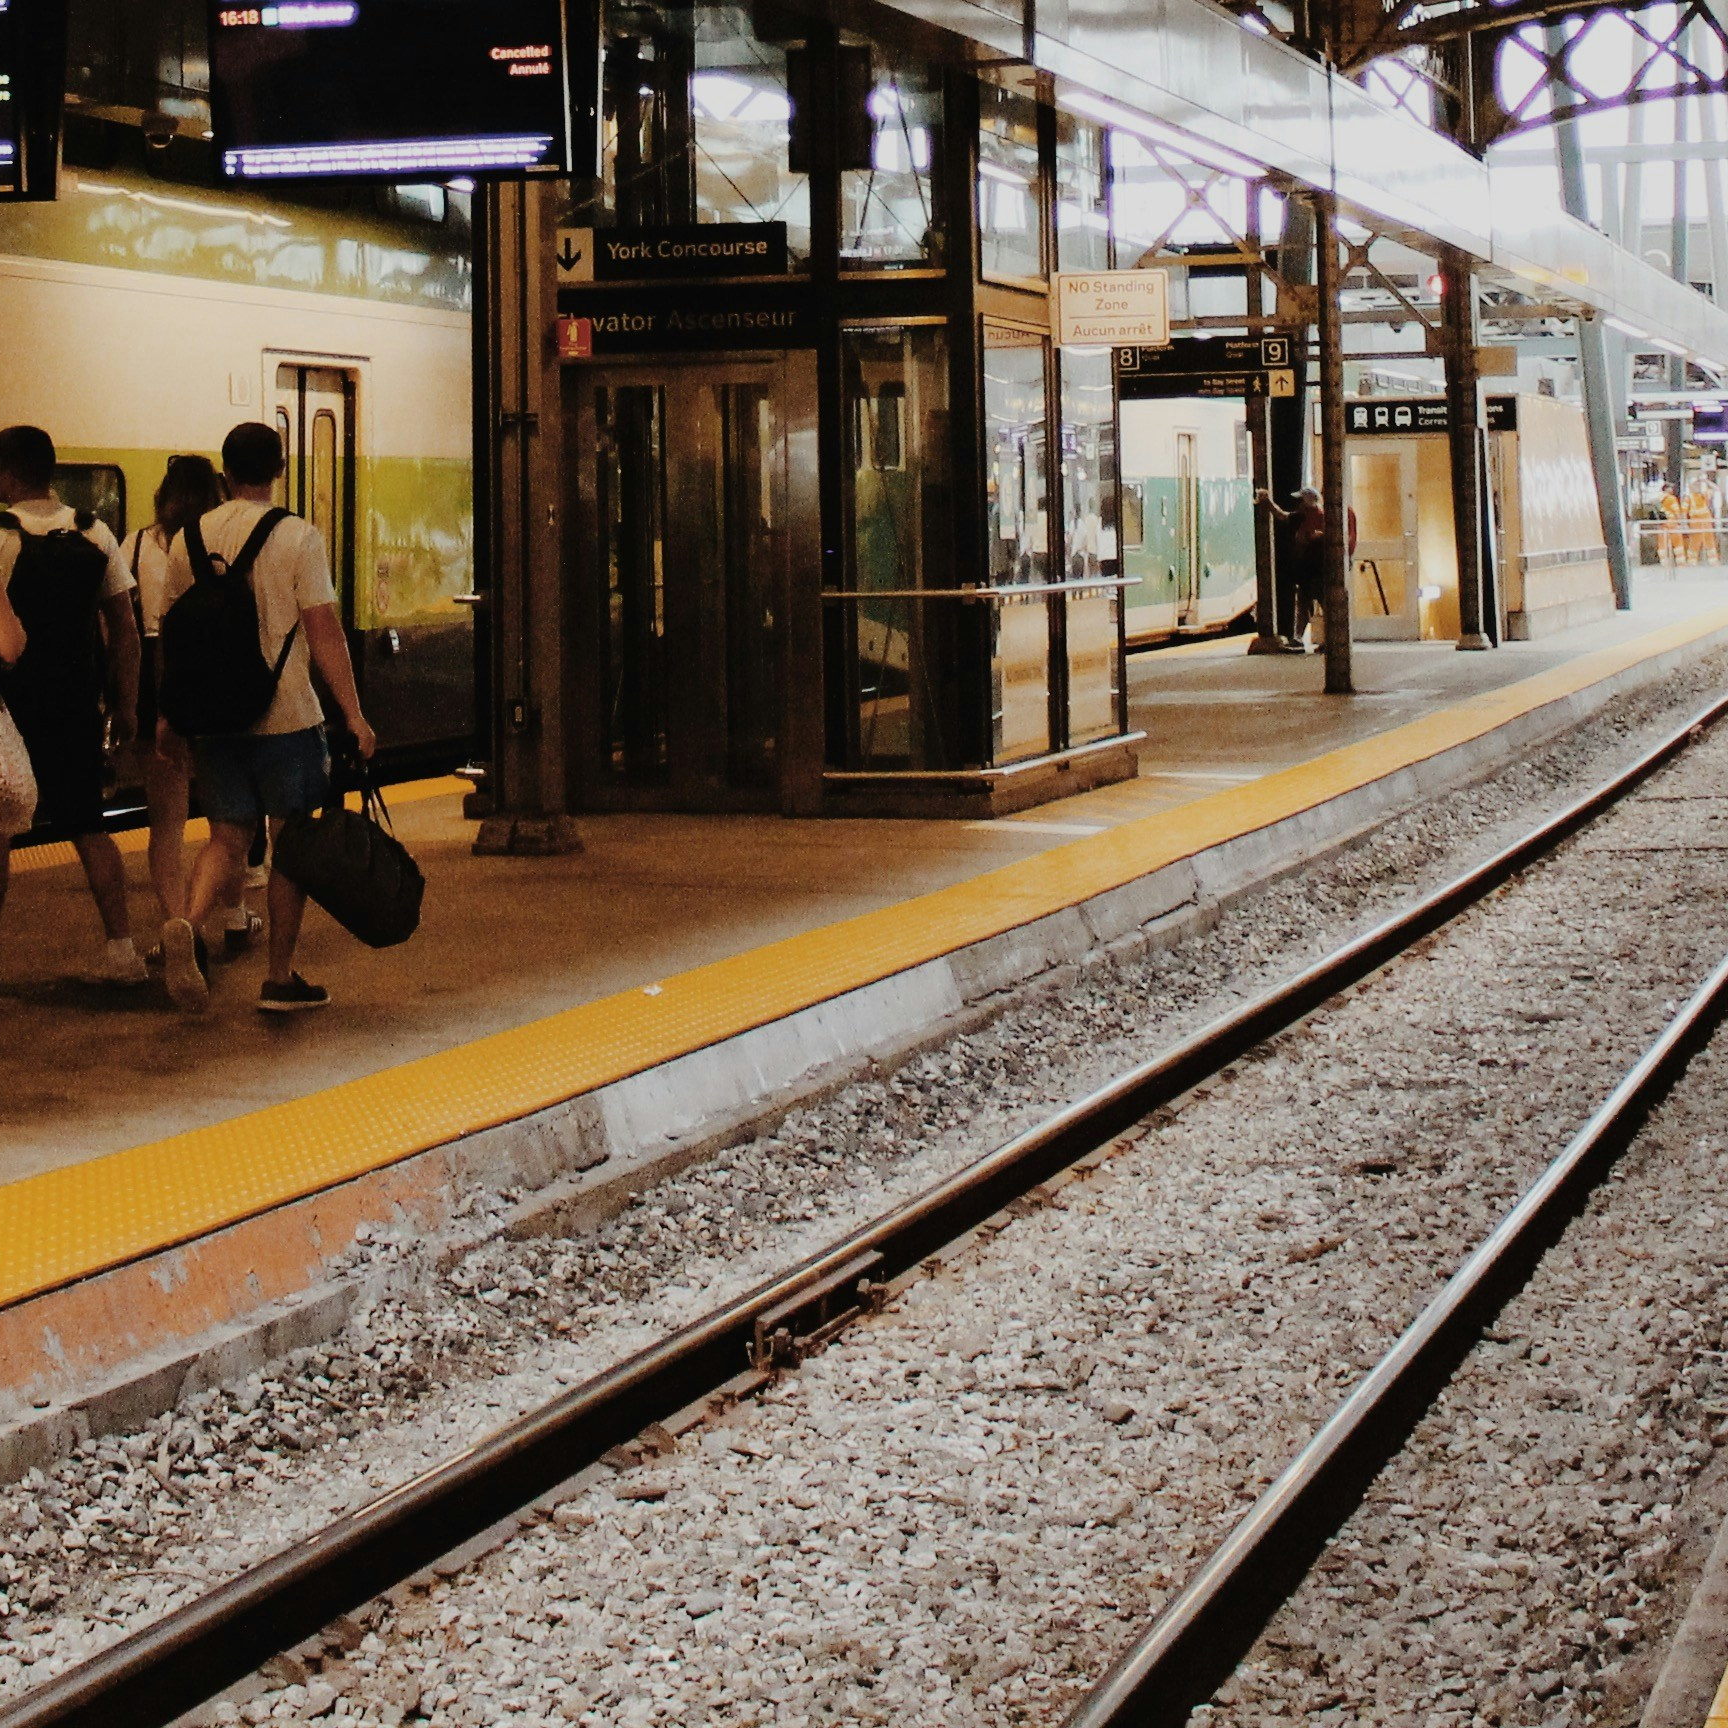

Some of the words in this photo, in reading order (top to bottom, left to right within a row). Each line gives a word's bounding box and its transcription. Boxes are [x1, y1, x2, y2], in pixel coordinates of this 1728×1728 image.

[490, 44, 549, 60] Cancelled
[509, 61, 550, 76] Annulé
[606, 240, 653, 261] York
[657, 239, 769, 259] Concourse
[1068, 280, 1091, 294] NO
[1092, 278, 1155, 294] Standing
[1094, 297, 1129, 311] Zone
[667, 309, 797, 332] Ascenseur
[1072, 324, 1116, 338] Aucun
[1118, 322, 1153, 336] arrêt
[1119, 347, 1134, 367] 8
[1268, 342, 1283, 362] 9
